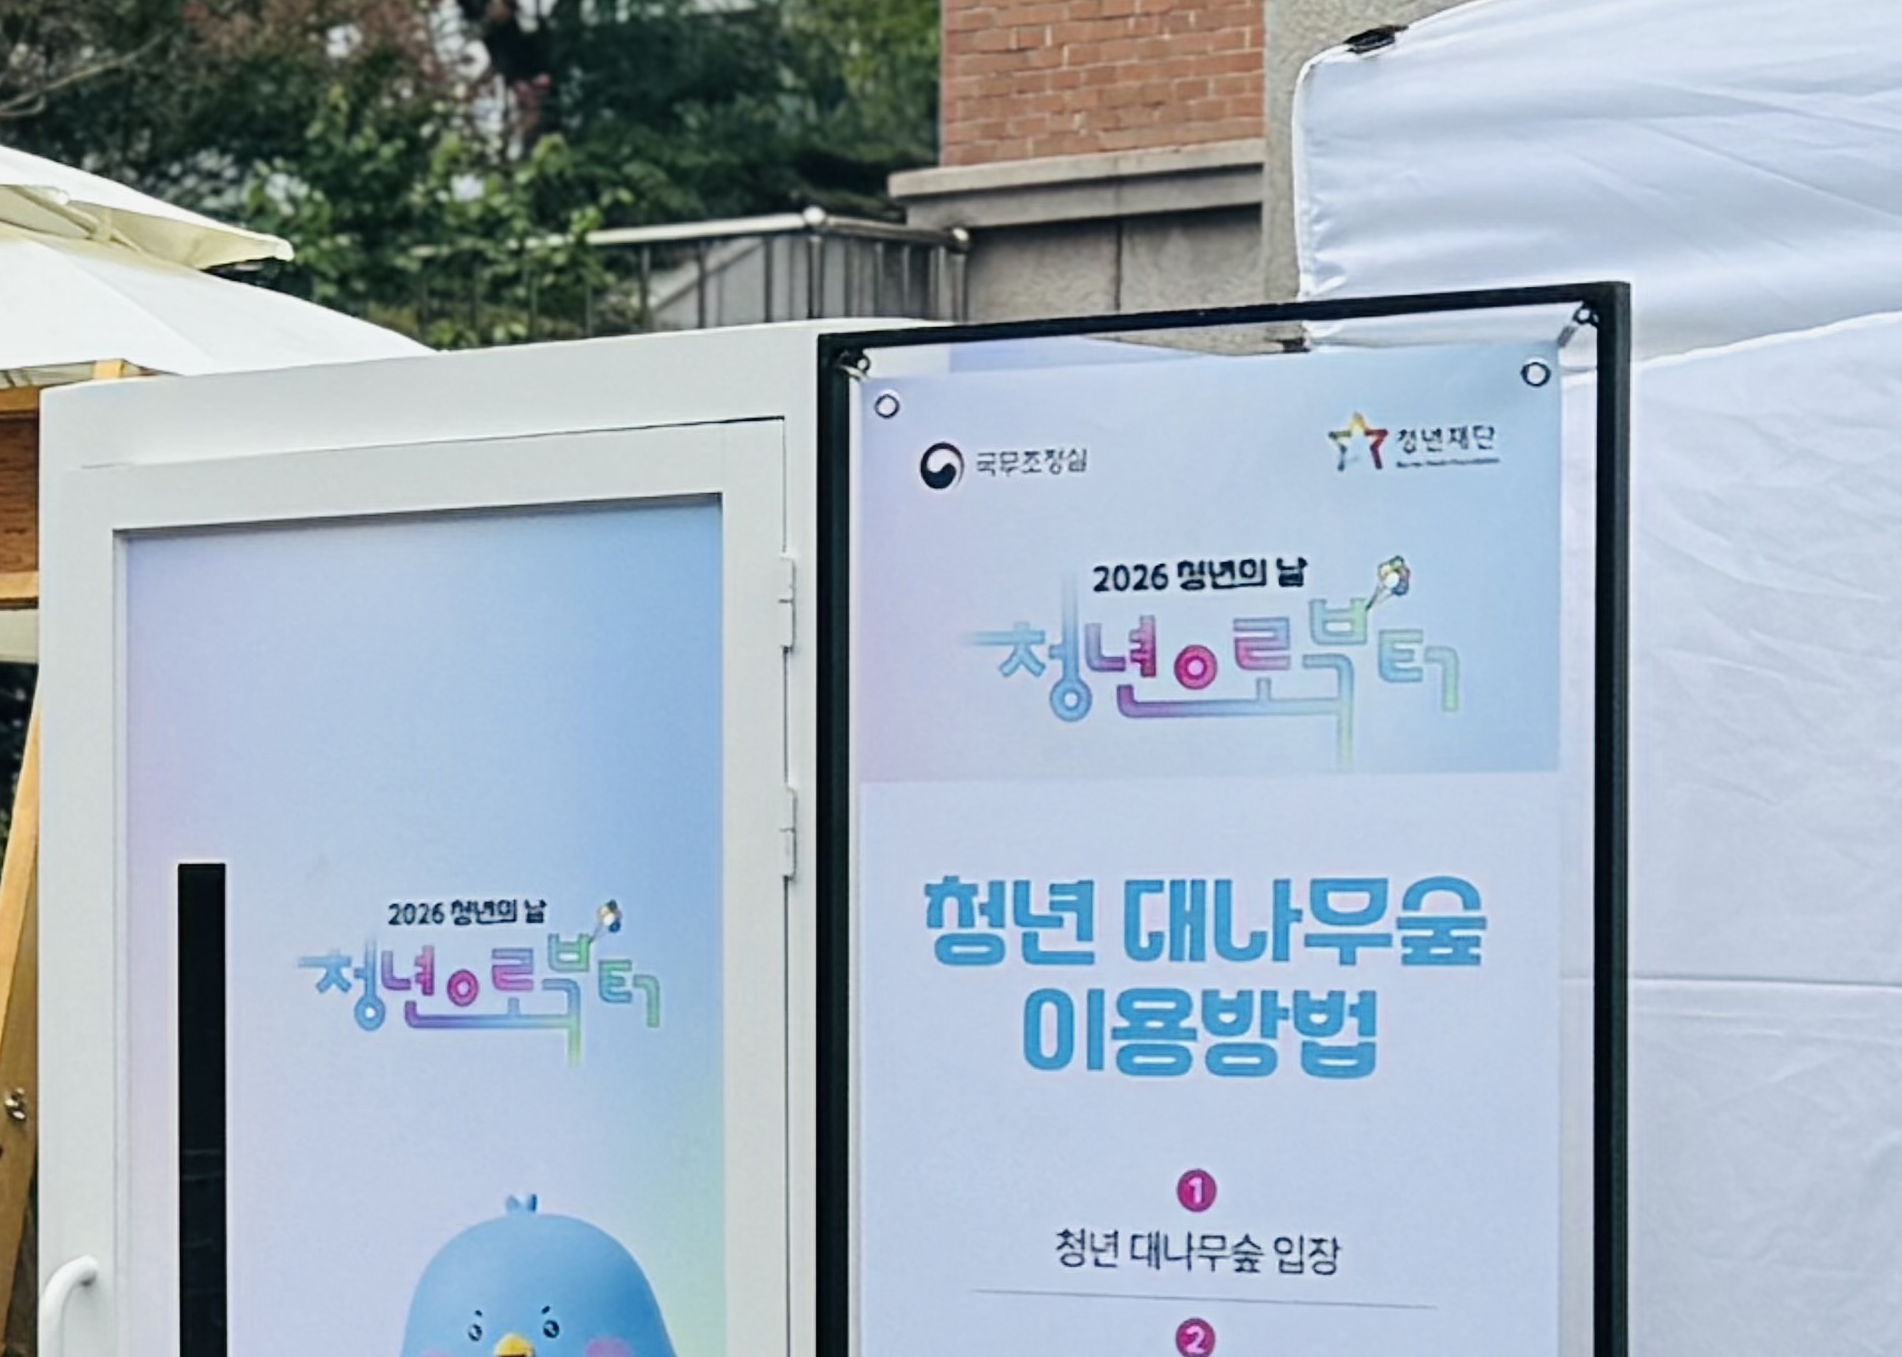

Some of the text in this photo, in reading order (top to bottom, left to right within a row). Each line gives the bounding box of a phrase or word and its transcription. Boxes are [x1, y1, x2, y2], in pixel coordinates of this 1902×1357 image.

[1396, 424, 1496, 454] 청년재단
[976, 445, 1088, 476] 국무조정실
[1093, 556, 1308, 592] 2026 청년의 날
[388, 898, 547, 926] 2026 청년의 날
[923, 875, 1487, 967] 청년 대나무숲
[1022, 987, 1378, 1079] 이용방법
[1055, 1227, 1342, 1277] 청년 대나무숲 입장
